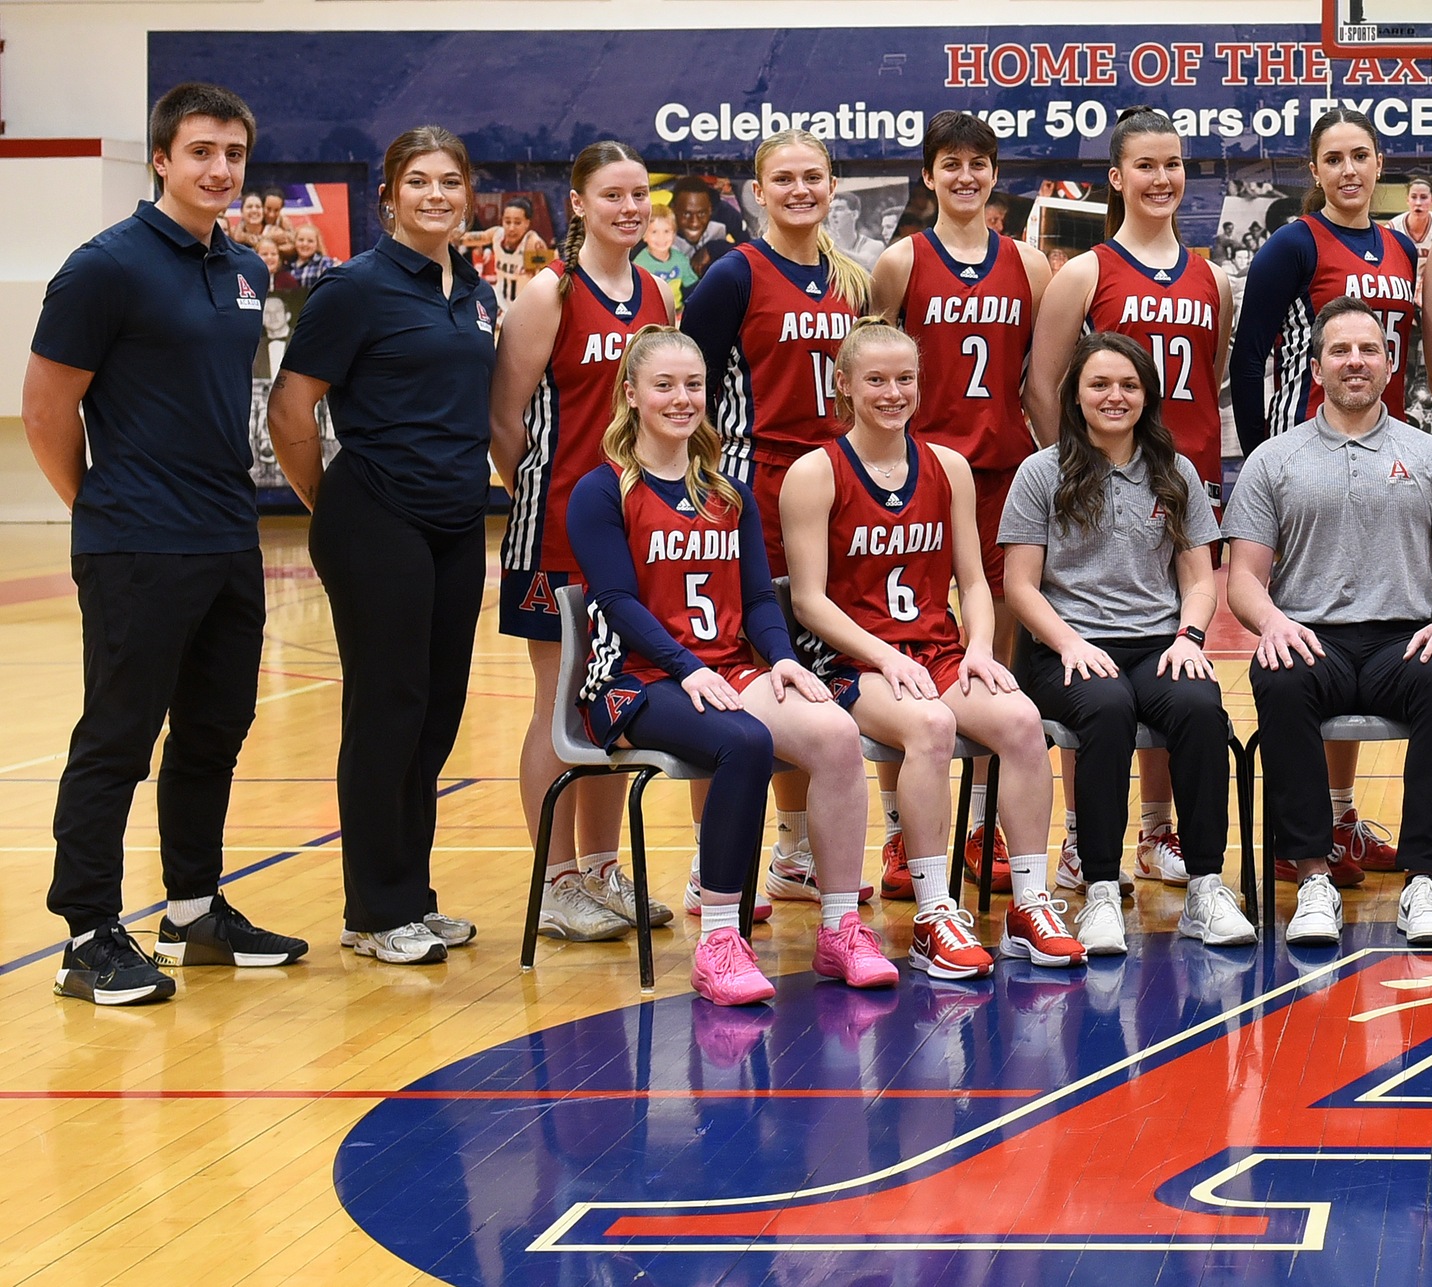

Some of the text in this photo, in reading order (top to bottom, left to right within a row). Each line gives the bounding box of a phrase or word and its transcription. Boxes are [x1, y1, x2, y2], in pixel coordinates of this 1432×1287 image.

[945, 43, 1117, 87] HOME
[1129, 43, 1203, 86] OF
[1215, 43, 1329, 85] THE
[655, 102, 924, 147] Celebrating
[962, 108, 1036, 138] ver
[1045, 100, 1107, 138] 50
[1252, 99, 1300, 137] of
[779, 311, 858, 342] ACADI
[923, 295, 1021, 326] ACADIA
[1119, 295, 1213, 331] ACADIA
[961, 334, 992, 398] 2
[1150, 334, 1194, 400] 12
[646, 529, 740, 563] ACADIA
[847, 521, 944, 557] ACADIA
[686, 572, 718, 641] 5
[886, 566, 920, 622] 6
